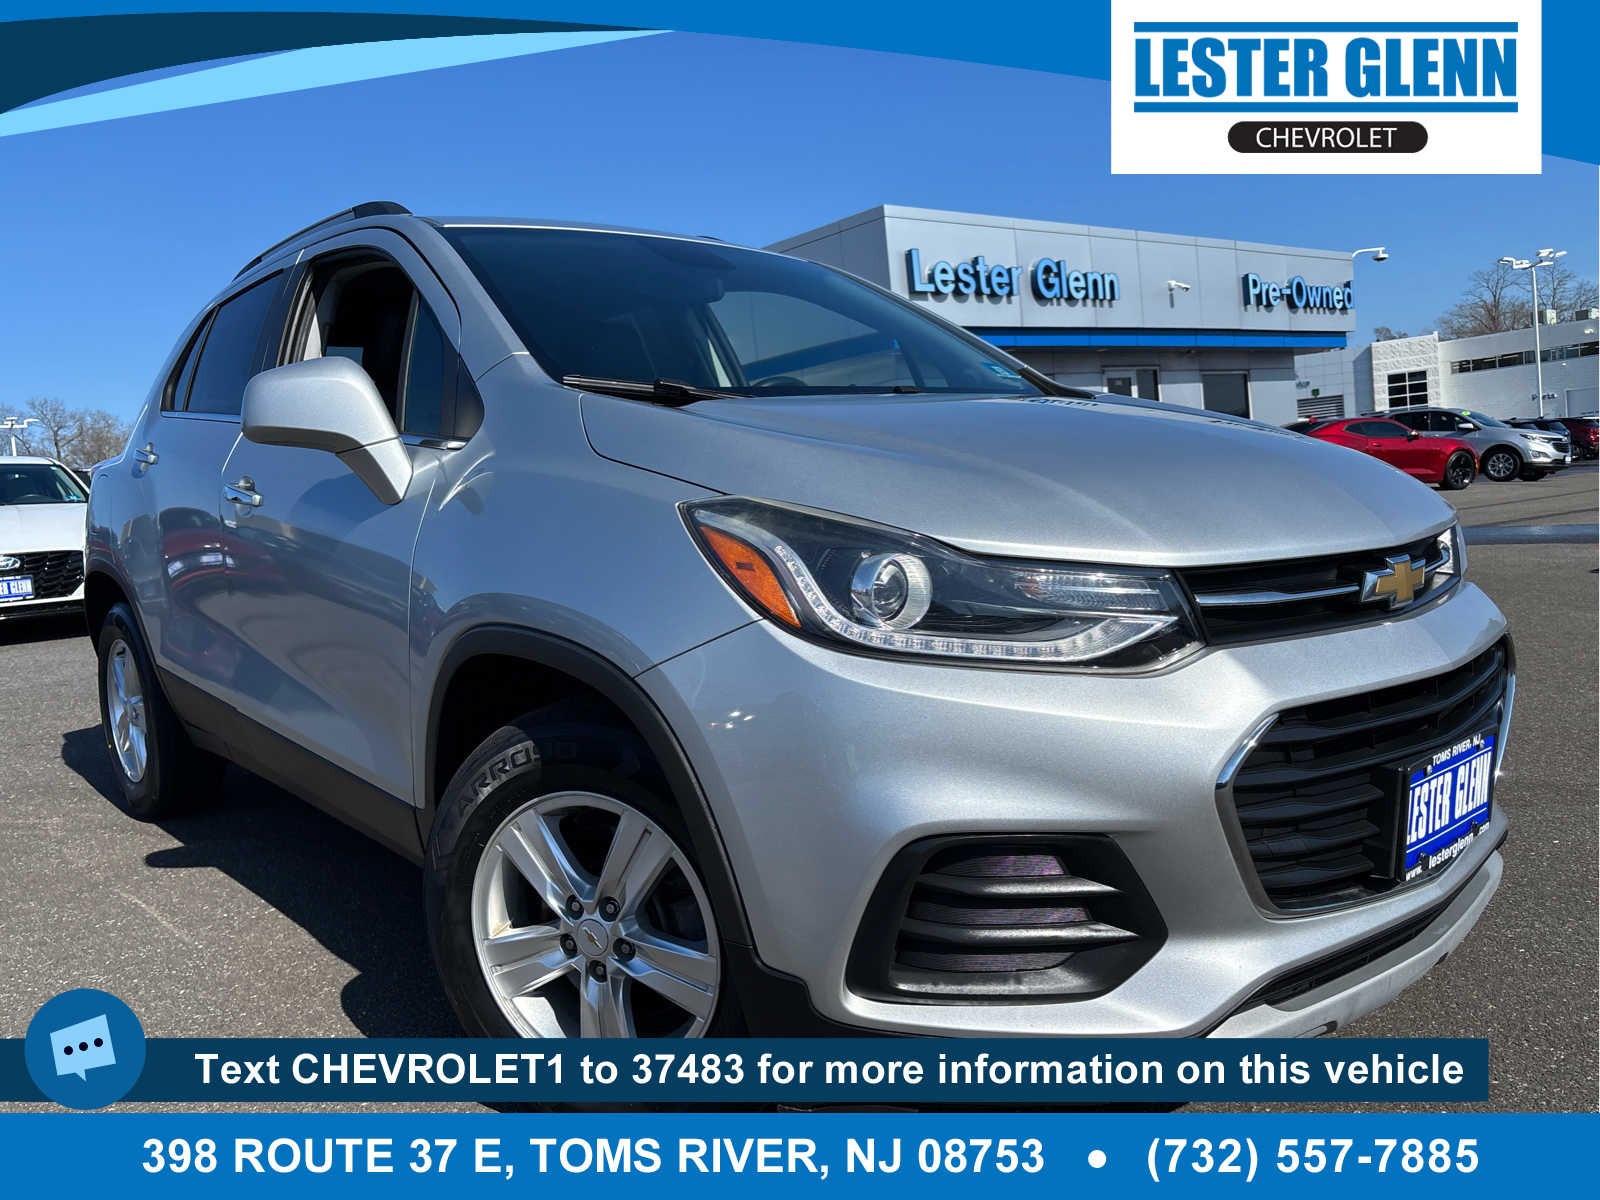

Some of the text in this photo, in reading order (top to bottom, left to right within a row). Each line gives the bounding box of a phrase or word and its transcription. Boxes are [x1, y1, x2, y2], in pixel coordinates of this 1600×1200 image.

[905, 247, 1120, 302] Lester Glenn
[1241, 272, 1354, 310] Pre-Owned
[1432, 748, 1452, 766] TOMS
[1406, 751, 1492, 845] LESTER GLENN
